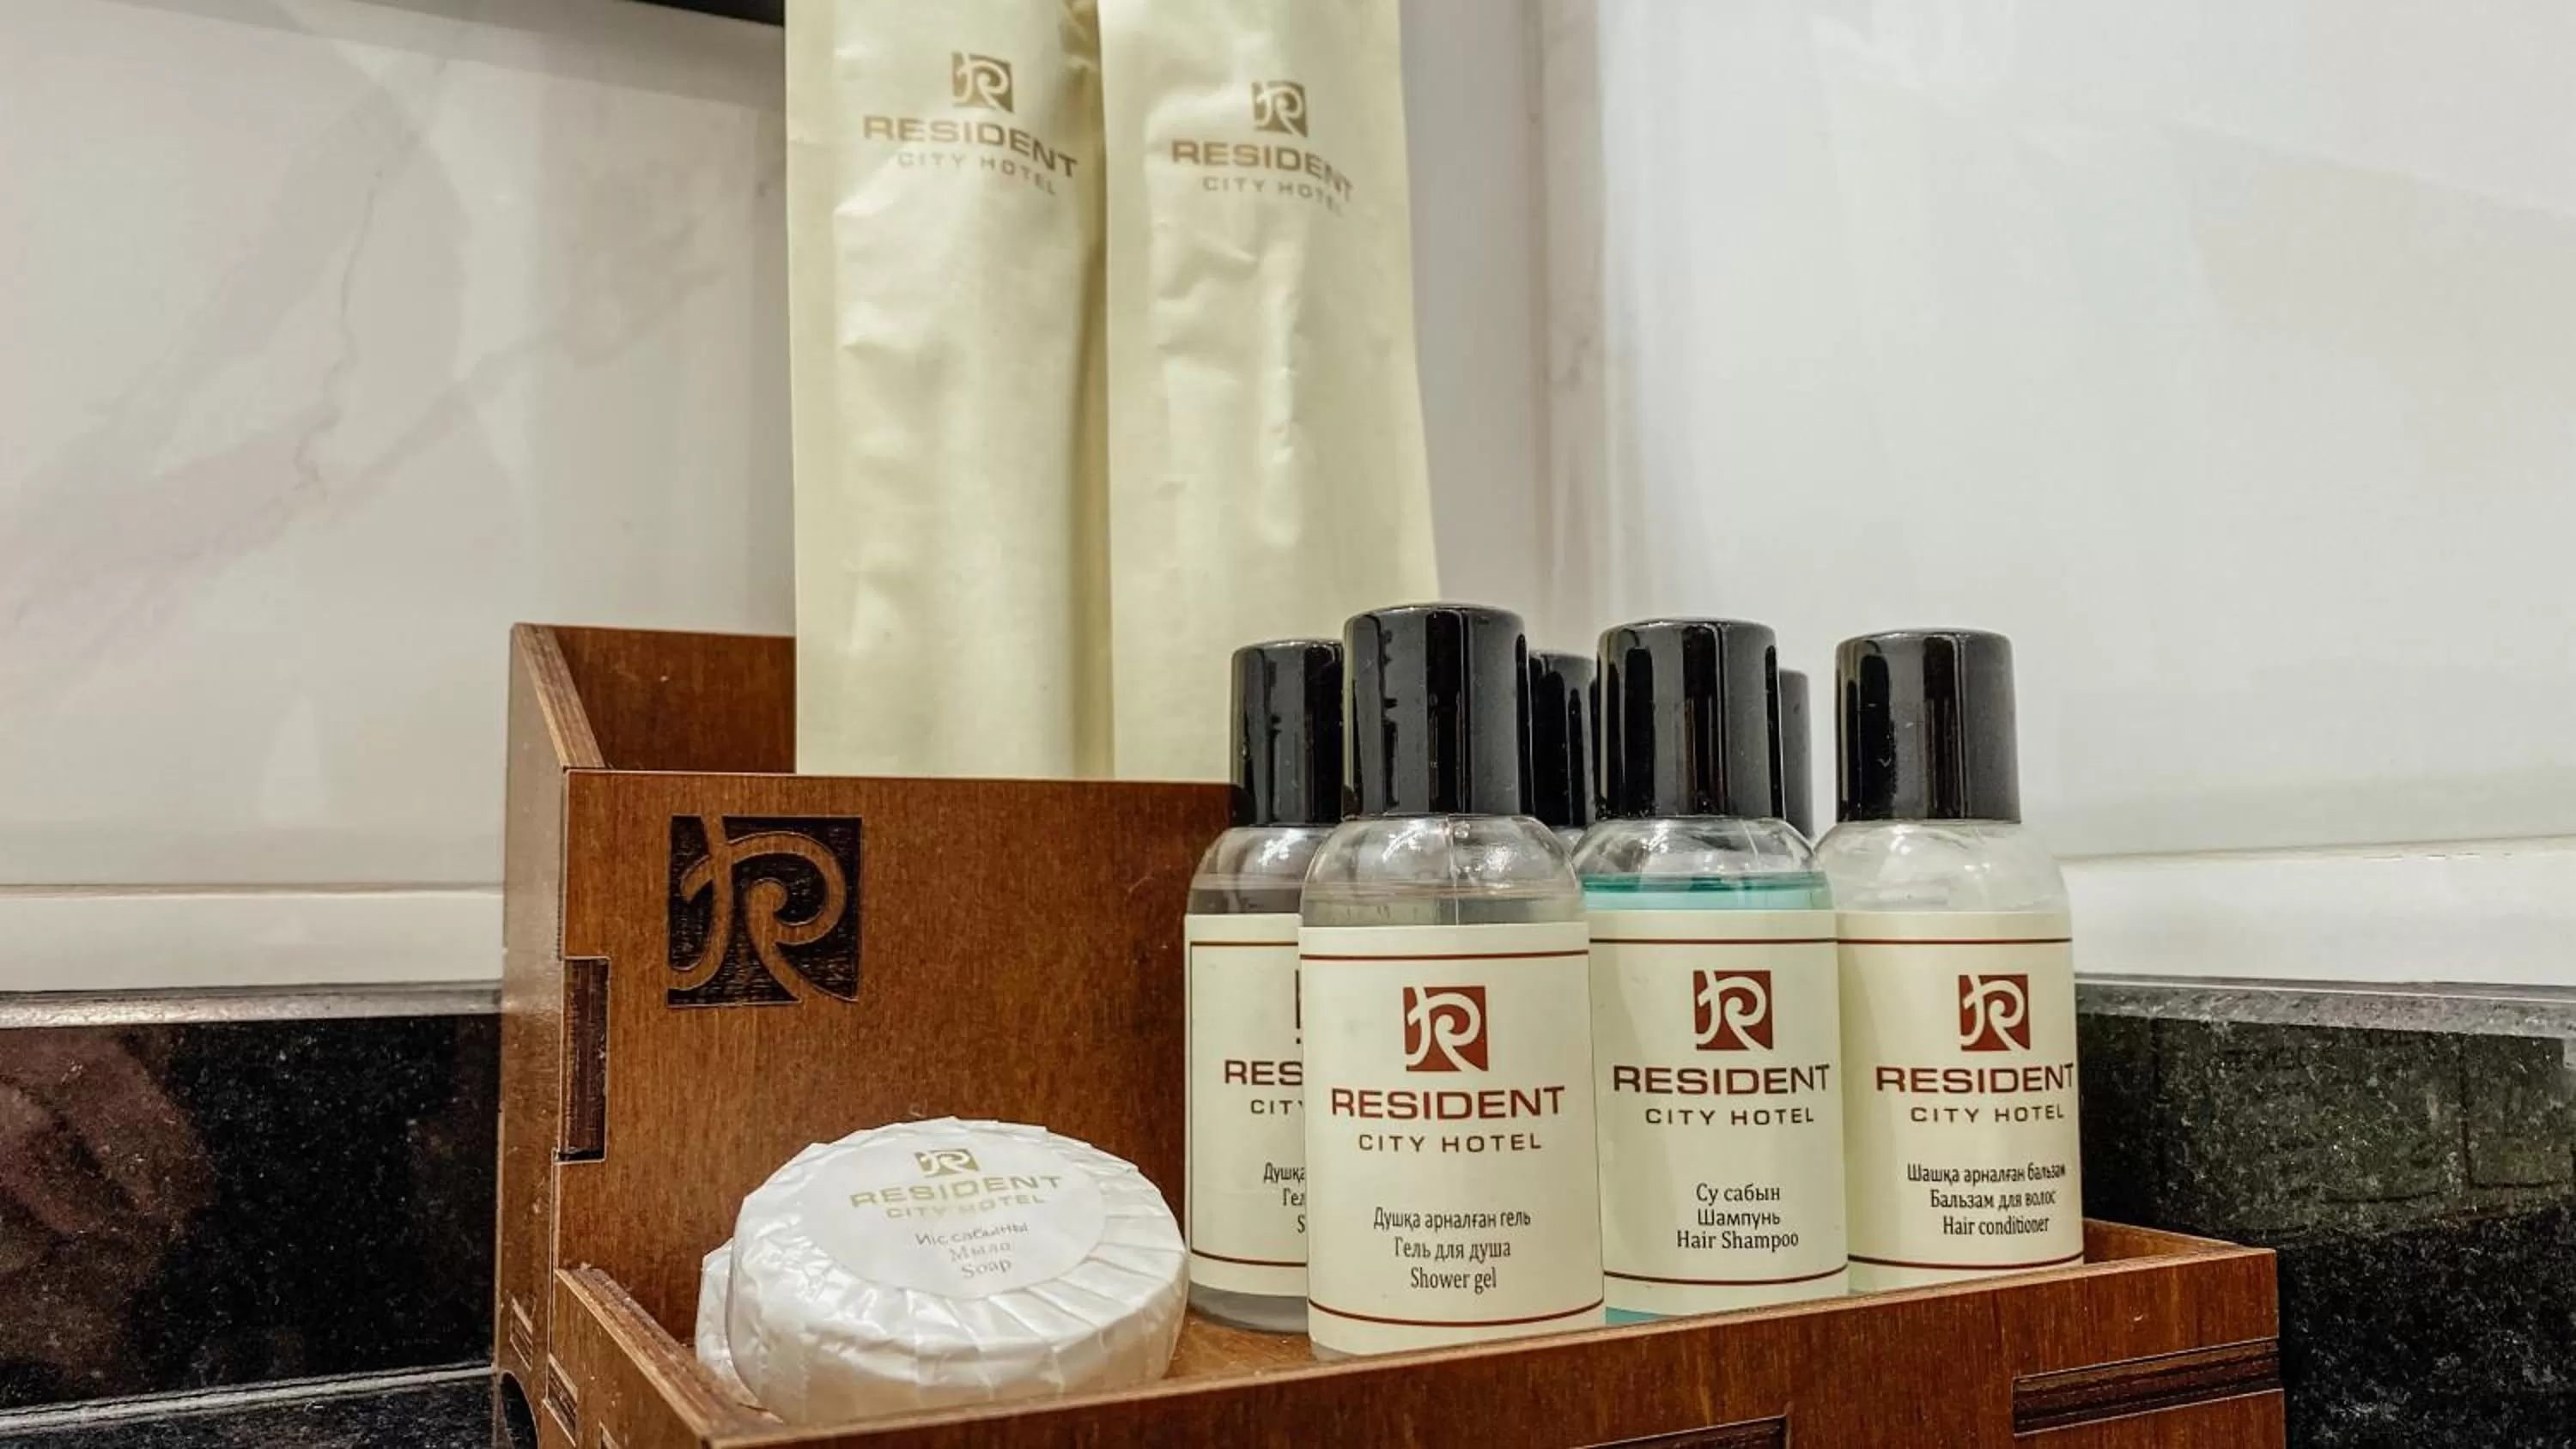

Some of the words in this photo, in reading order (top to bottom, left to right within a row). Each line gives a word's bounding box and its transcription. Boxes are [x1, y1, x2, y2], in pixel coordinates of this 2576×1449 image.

[862, 115, 1078, 179] RESIDENT
[898, 152, 966, 170] CITY
[981, 155, 1056, 196] HOTEL
[1172, 140, 1354, 203] RESIDENT
[1202, 176, 1266, 193] CITY
[1613, 1064, 1830, 1094] RESIDENT
[1875, 1063, 2074, 1094] RESIDENT
[1332, 1086, 1565, 1120] RESIDENT
[1911, 1106, 1979, 1123] CITY
[1994, 1105, 2064, 1122] HOTEL
[1645, 1108, 1716, 1125] CITY
[1730, 1107, 1814, 1125] HOTEL
[1358, 1134, 1425, 1152] CITY
[1442, 1133, 1541, 1153] HOTEL
[1907, 1163, 1959, 1186] Шашқа
[1964, 1167, 2026, 1186] арналған
[849, 1175, 1062, 1208] RESIDENT
[1696, 1182, 1719, 1206] Су
[1723, 1183, 1781, 1202] сабын
[1930, 1189, 1995, 1209] Бальзам
[1998, 1193, 2022, 1211] для
[2025, 1191, 2057, 1207] волос
[885, 1205, 950, 1220] CITY
[957, 1194, 1046, 1214] HOTEL
[1698, 1209, 1781, 1230] Шампунь
[1374, 1206, 1421, 1232] Душқа
[1425, 1212, 1497, 1234] арналған
[1500, 1211, 1531, 1228] гель
[1943, 1216, 1975, 1235] Hair
[1978, 1216, 2050, 1236] conditioner
[1394, 1235, 1431, 1258] Гель
[1435, 1244, 1465, 1262] для
[1469, 1242, 1511, 1264] душа
[1677, 1229, 1716, 1249] Hair
[1722, 1230, 1799, 1253] Shampoo
[961, 1258, 1012, 1278] Soap
[1411, 1266, 1470, 1288] Shower
[1474, 1266, 1497, 1294] gel
